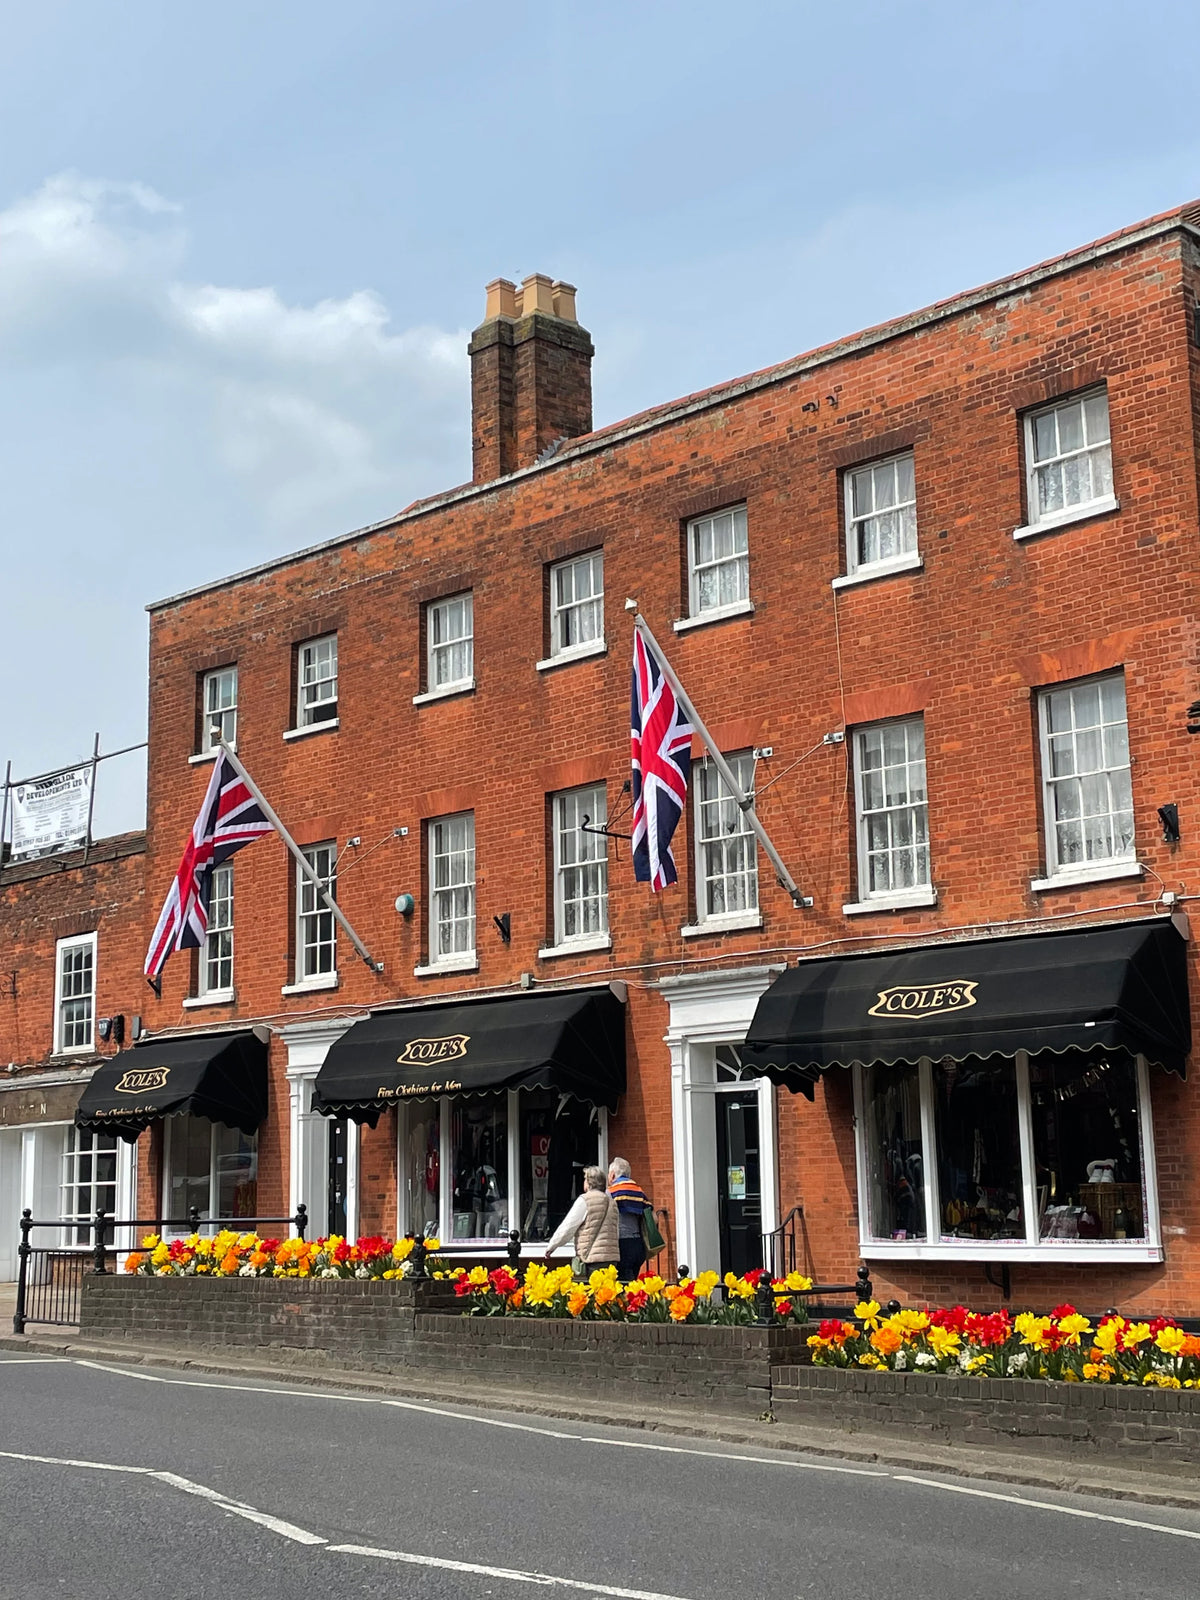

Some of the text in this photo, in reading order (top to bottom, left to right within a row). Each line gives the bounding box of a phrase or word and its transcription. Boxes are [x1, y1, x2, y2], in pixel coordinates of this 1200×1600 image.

[72, 778, 83, 788] LTD
[885, 986, 963, 1011] COLE'S
[409, 1040, 461, 1060] COLE'S
[124, 1071, 163, 1088] COLE'S
